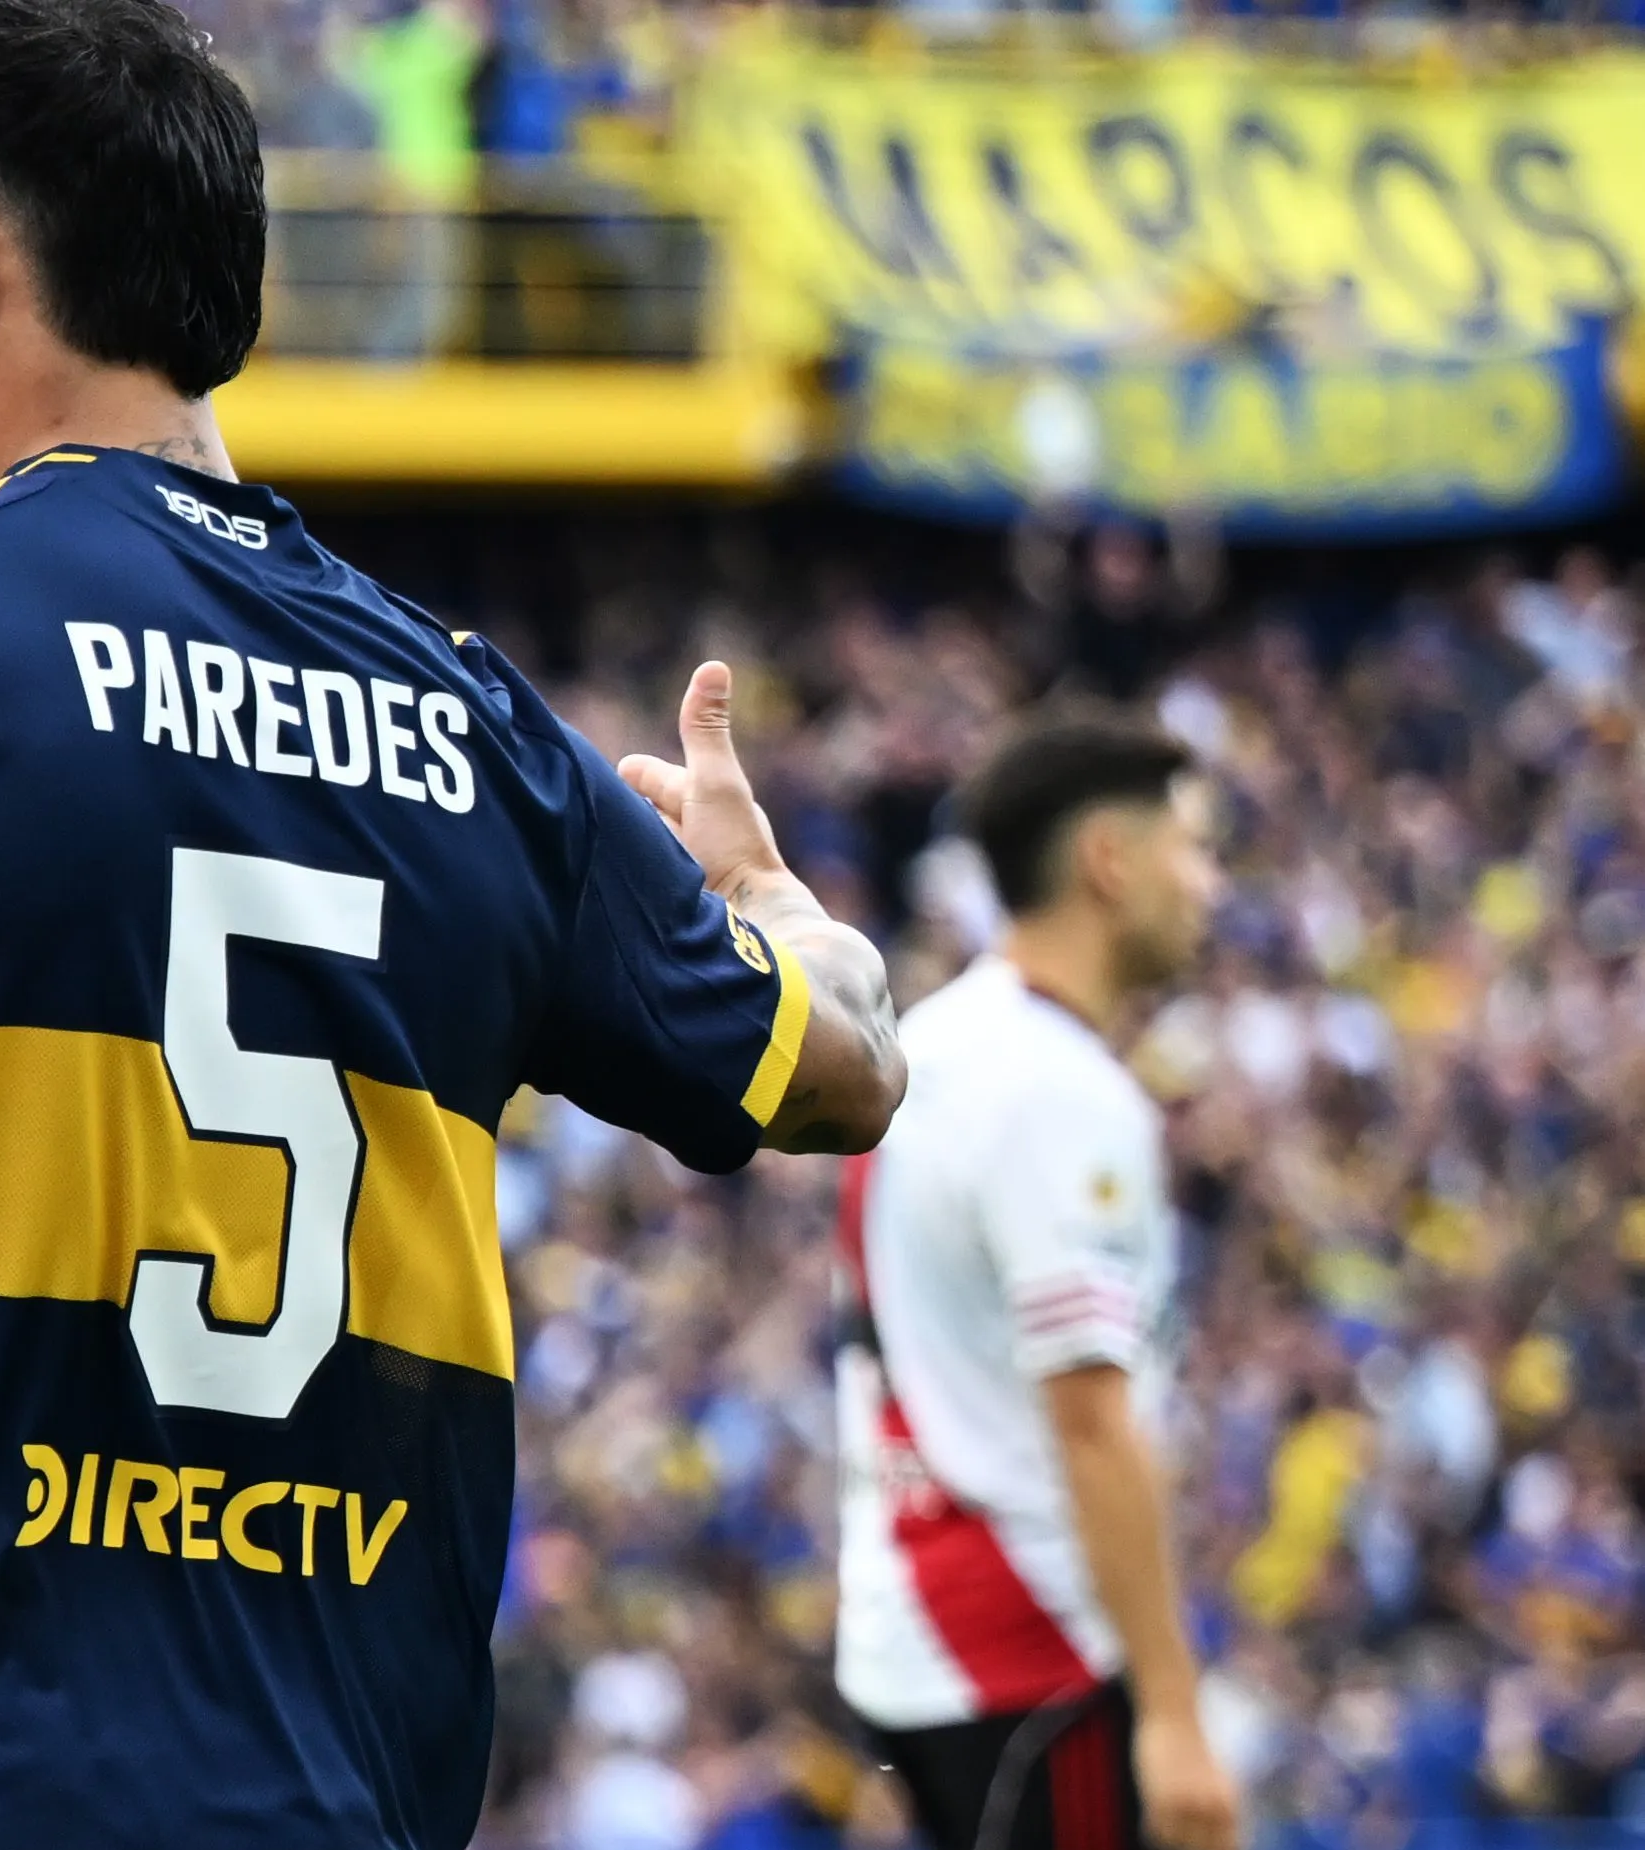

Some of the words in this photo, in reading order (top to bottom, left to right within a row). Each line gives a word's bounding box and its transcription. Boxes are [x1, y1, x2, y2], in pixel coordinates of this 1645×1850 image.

[154, 484, 269, 551] 1905
[65, 621, 475, 815] PAREDES
[129, 847, 385, 1418] 5
[16, 1443, 408, 1586] DIRECTV
